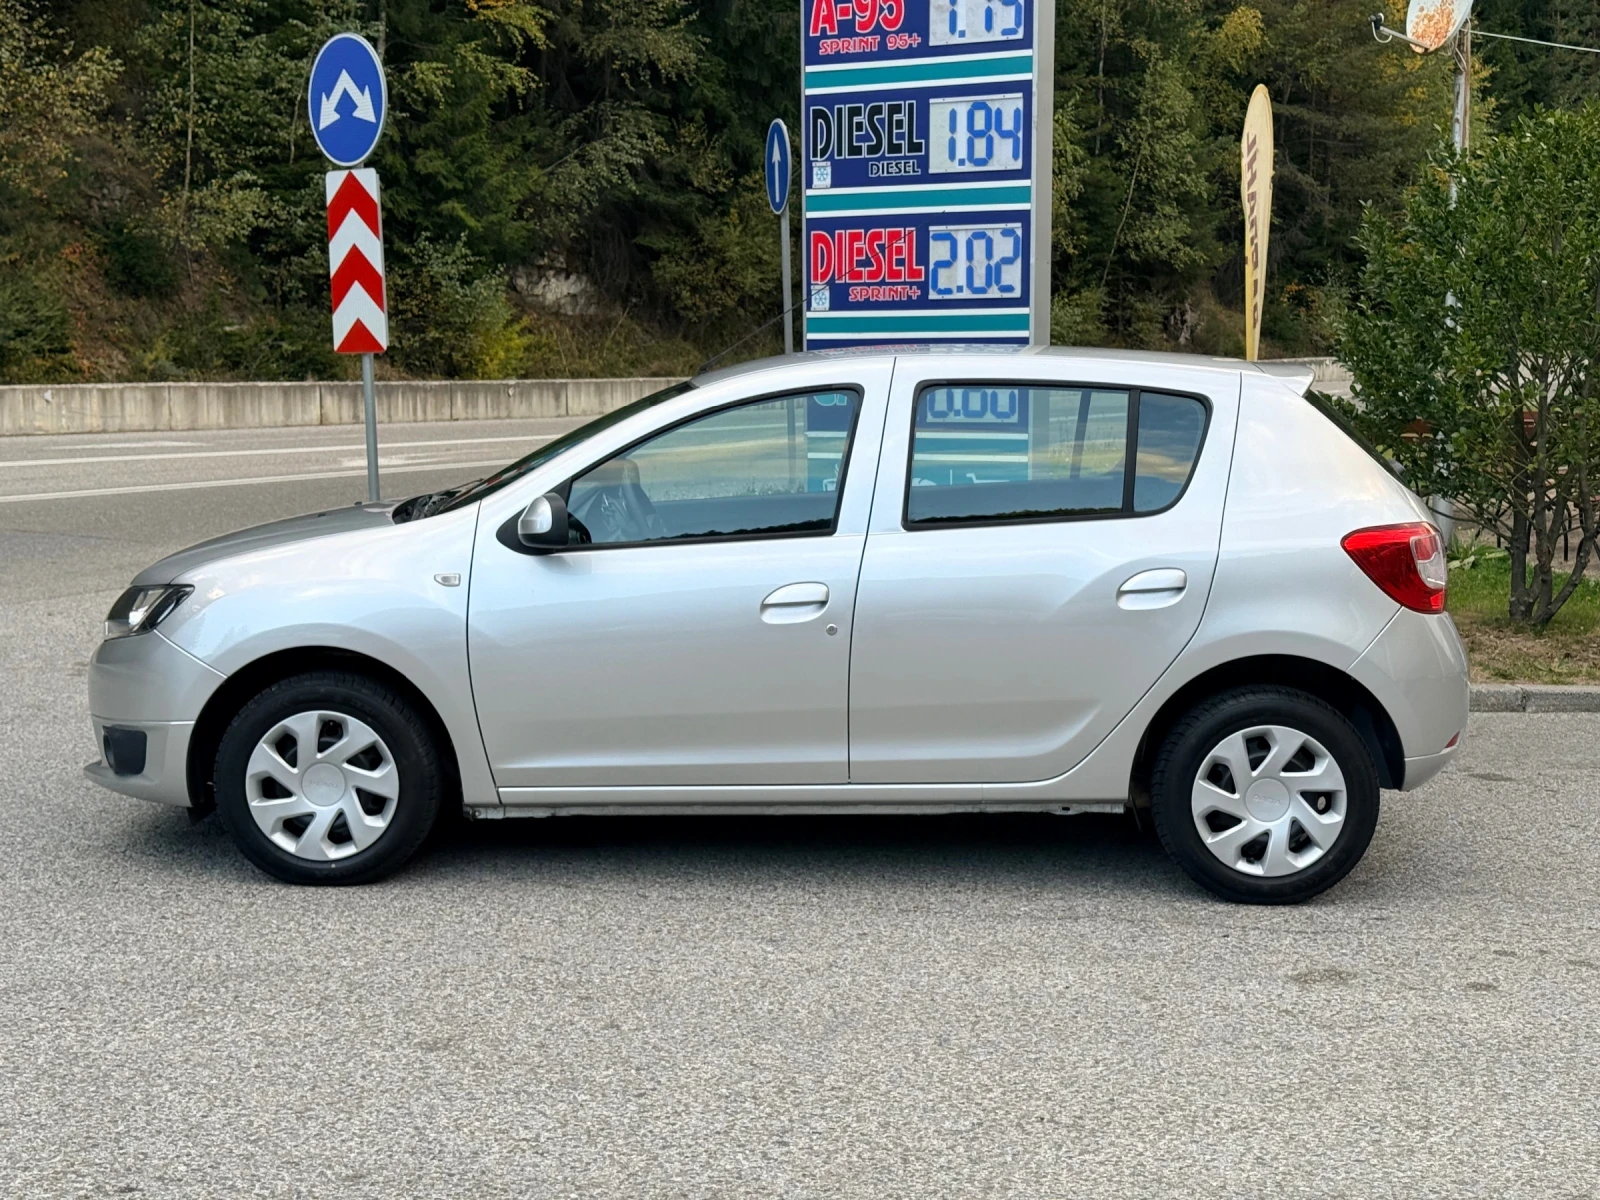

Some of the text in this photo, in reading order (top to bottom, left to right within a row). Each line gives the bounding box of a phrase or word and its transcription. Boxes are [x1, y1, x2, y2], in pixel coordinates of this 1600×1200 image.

[809, 0, 905, 37] A-95
[819, 33, 921, 55] SPRINT 95+
[810, 100, 925, 161] DIESEL
[948, 101, 1022, 167] 1.84
[868, 159, 921, 177] DIESEL
[810, 227, 925, 285] DIESEL
[930, 228, 1021, 295] 2.02
[848, 285, 921, 302] SPRINT+
